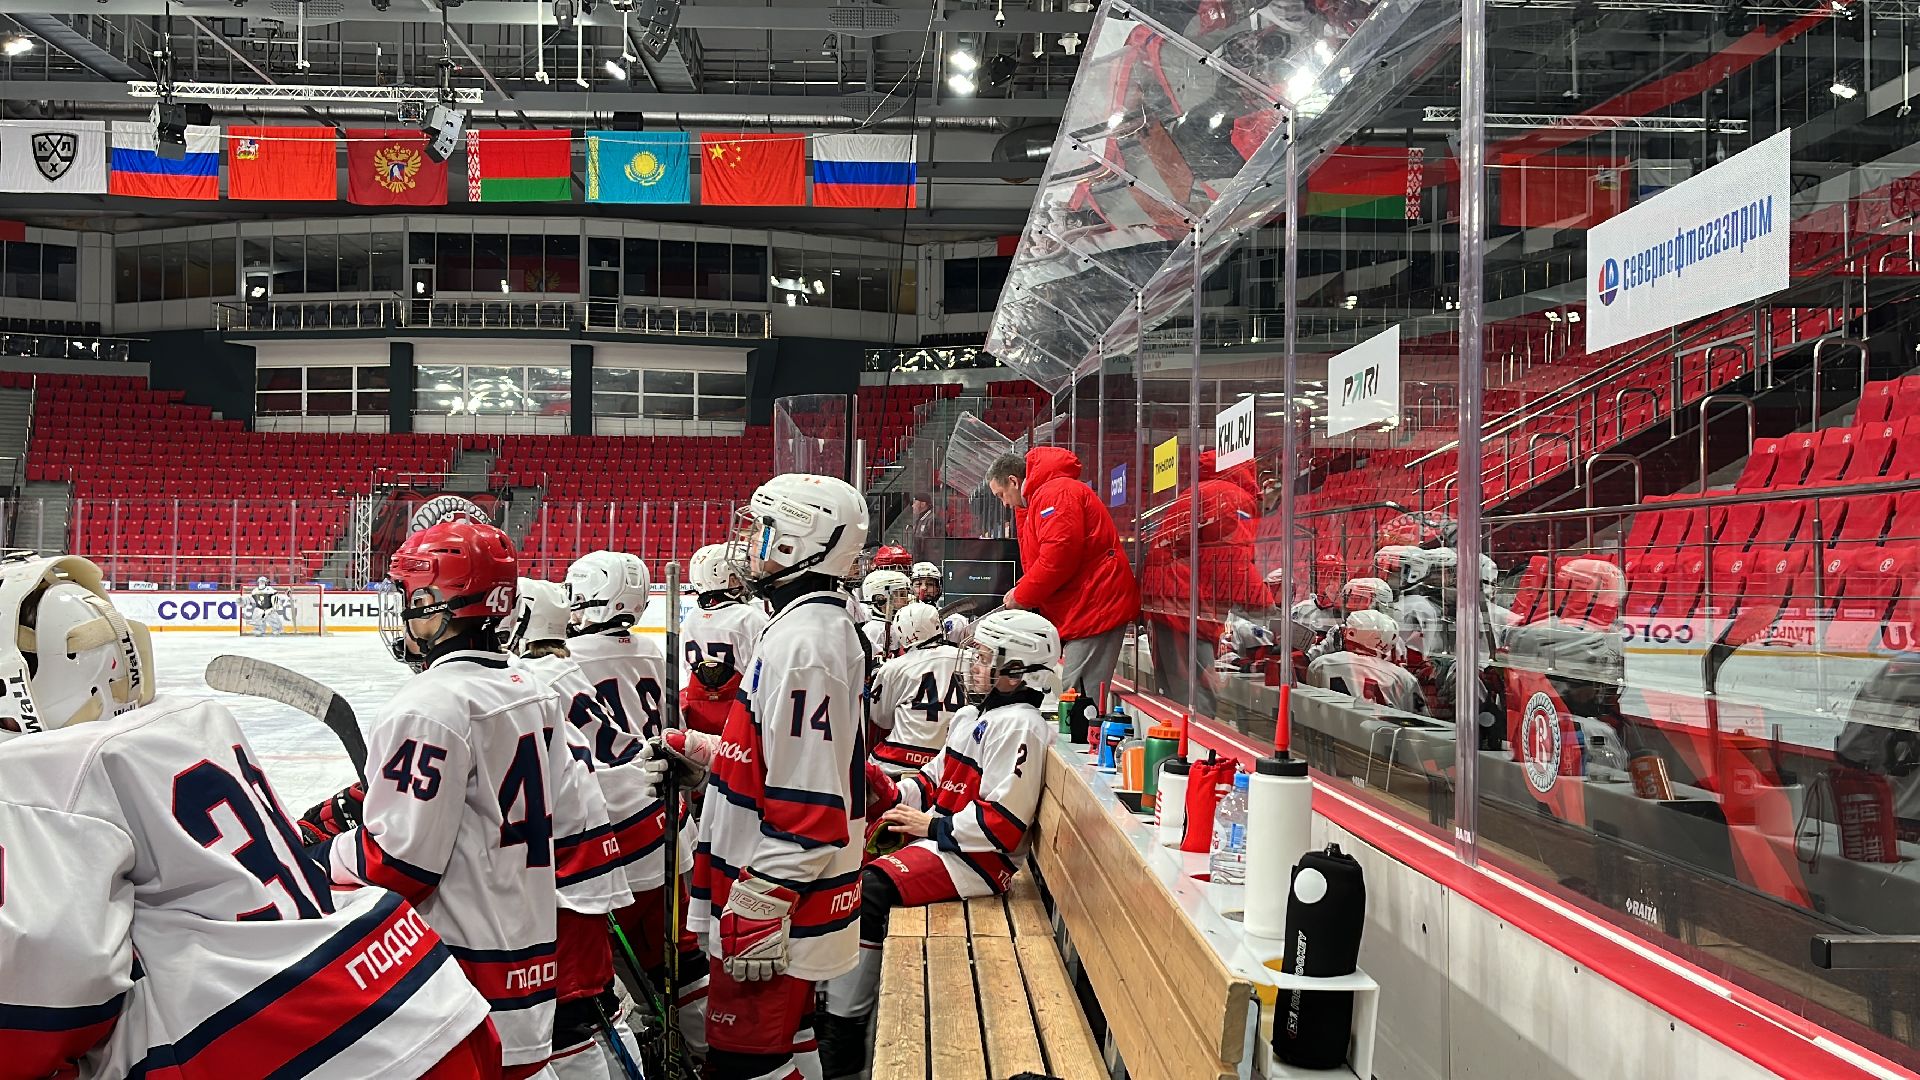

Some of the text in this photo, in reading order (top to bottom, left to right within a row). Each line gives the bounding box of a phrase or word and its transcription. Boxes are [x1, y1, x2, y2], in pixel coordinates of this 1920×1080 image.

[1218, 411, 1251, 457] KHL.RU
[485, 586, 513, 612] 45
[788, 689, 833, 741] 14
[911, 671, 966, 722] 44
[382, 738, 448, 801] 45
[498, 727, 554, 868] 4
[1632, 901, 1657, 924] RAITA
